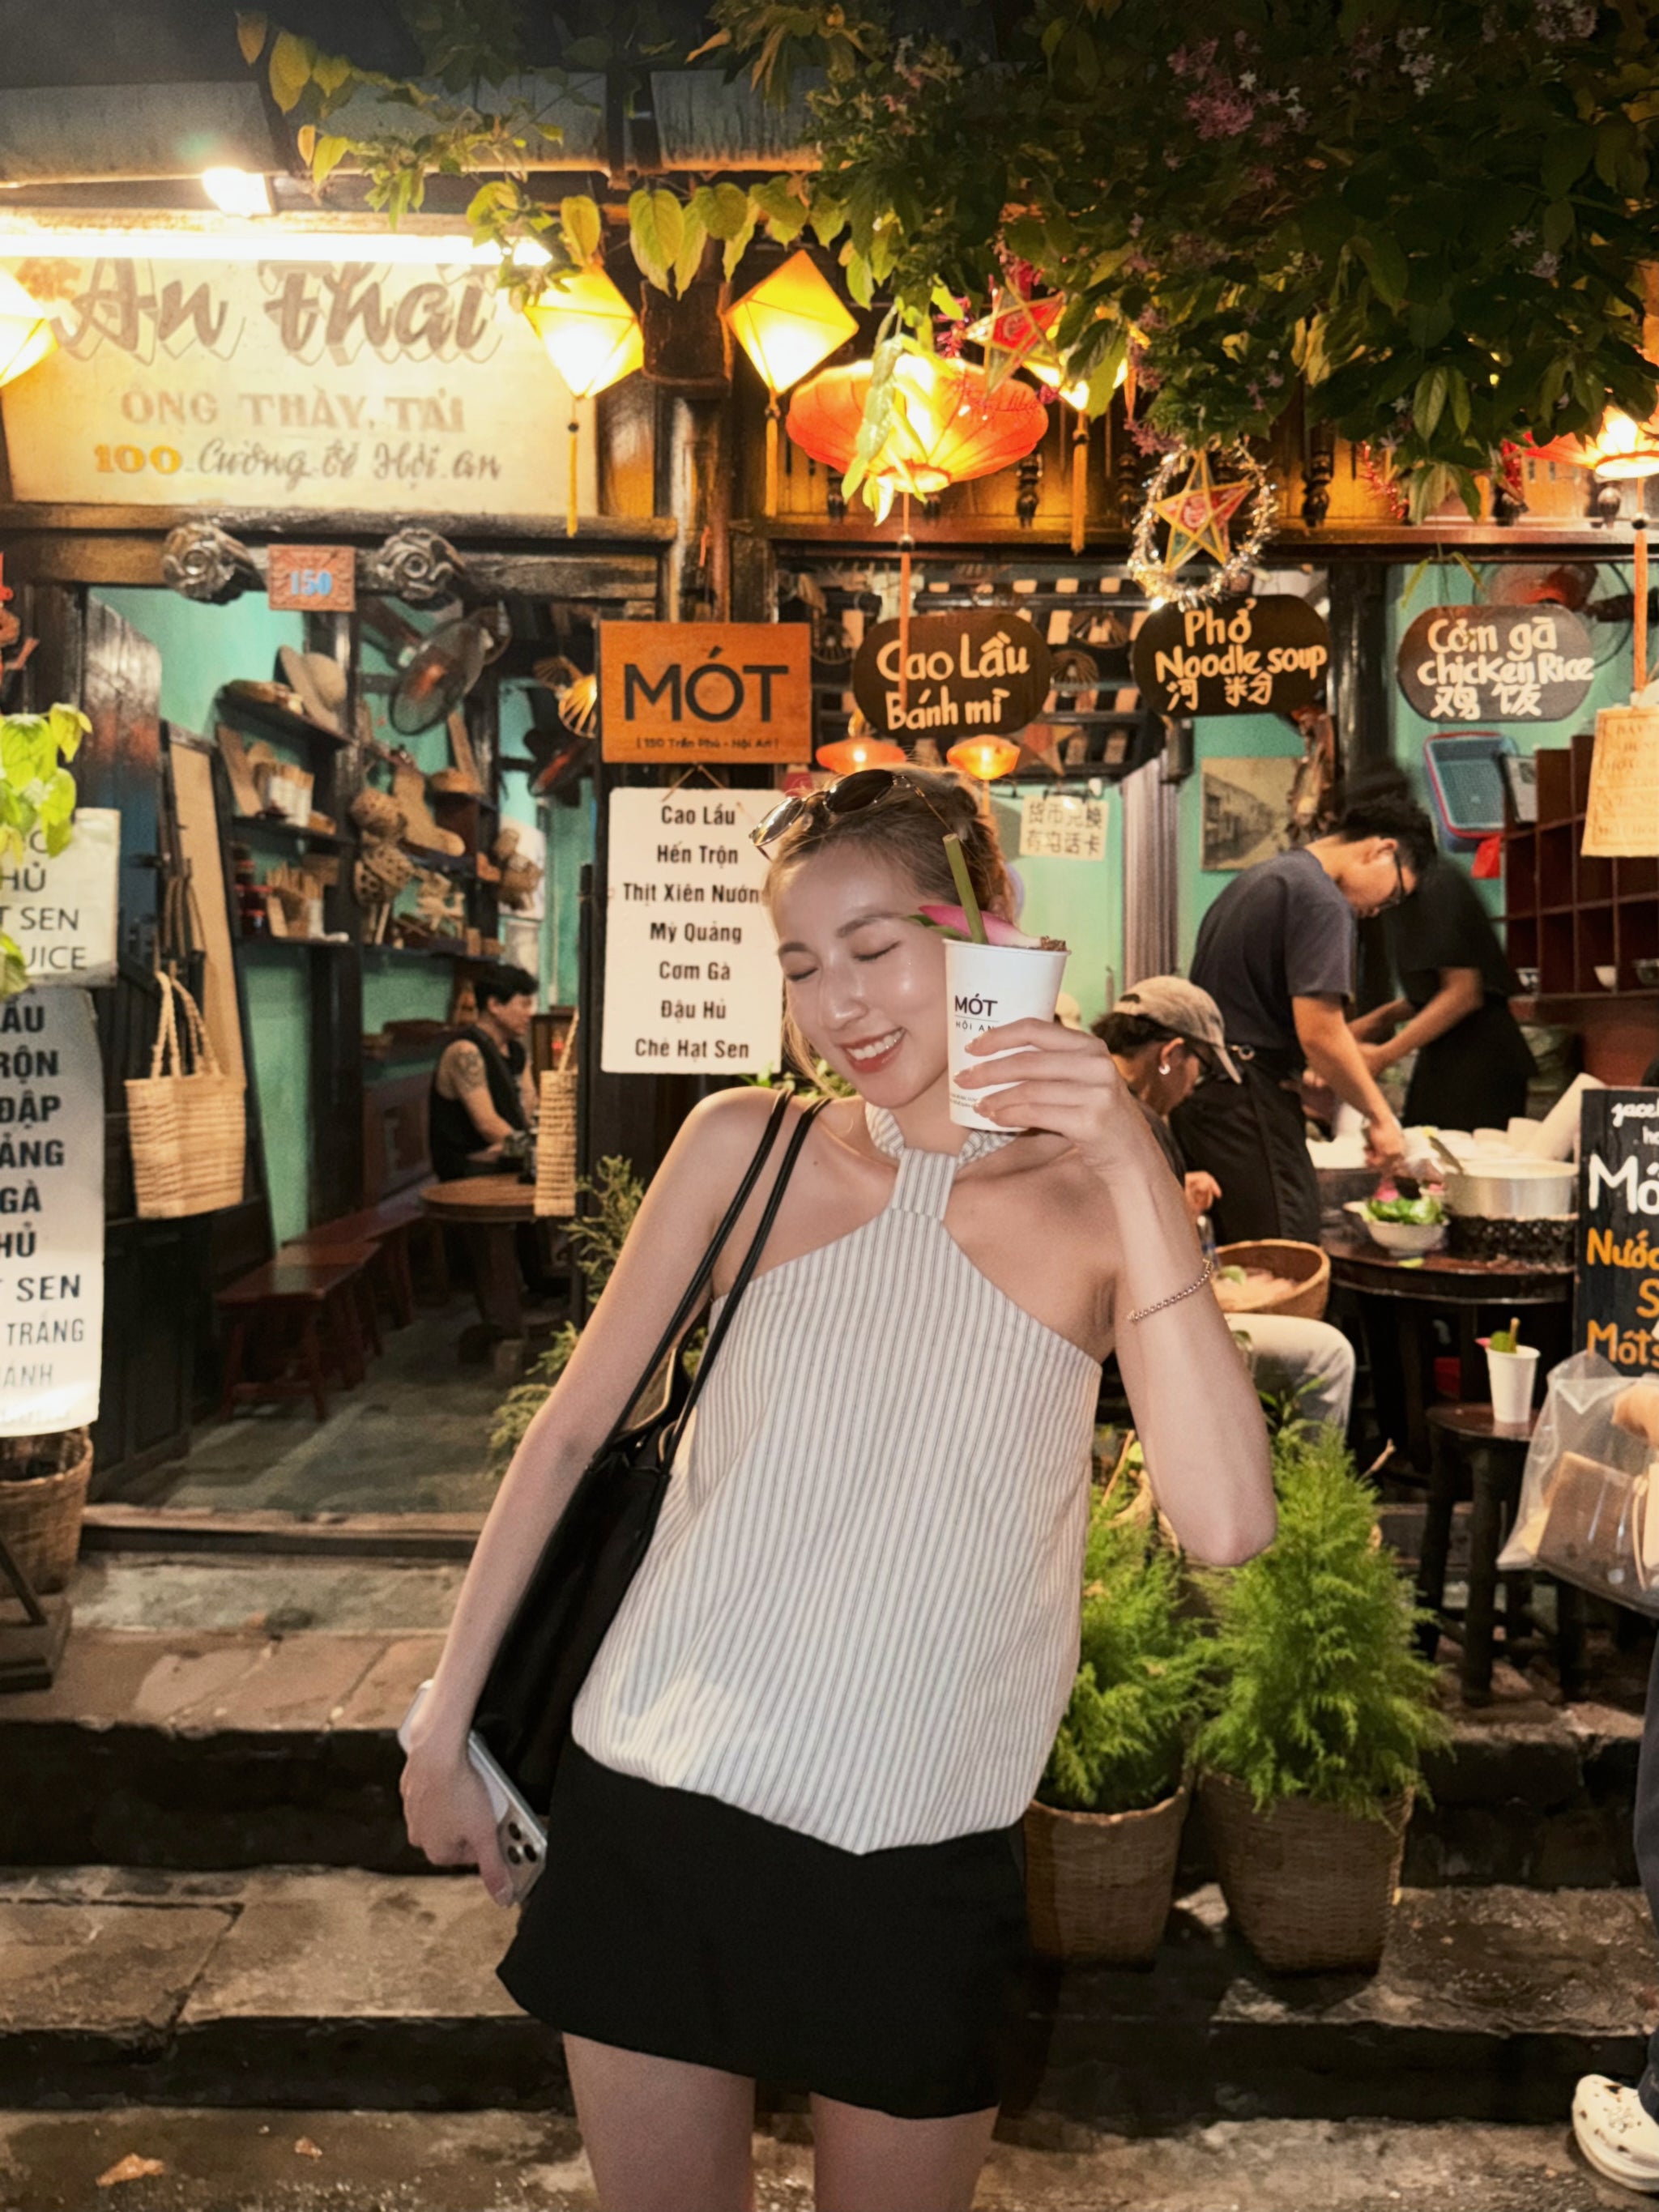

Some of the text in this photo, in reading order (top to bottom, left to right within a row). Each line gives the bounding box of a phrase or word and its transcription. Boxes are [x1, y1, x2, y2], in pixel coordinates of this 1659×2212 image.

[93, 442, 182, 475] 100
[291, 569, 333, 597] 150
[1184, 597, 1257, 648] Phở
[876, 631, 1030, 682] Cao Lầu
[1154, 644, 1328, 684] Noodle soup
[1537, 652, 1595, 684] Rice
[624, 646, 789, 722] MÓT
[885, 685, 959, 731] Bánh
[661, 805, 696, 825] Cao
[657, 841, 739, 868] Hến Trộn
[623, 882, 760, 906] Thịt Xiên Nướn
[20, 906, 79, 931] SEN
[684, 920, 742, 944] Quảng
[659, 961, 731, 981] Cơm Gà
[661, 999, 696, 1023] Đậu
[954, 993, 998, 1016] MÓT
[677, 1039, 707, 1062] Hạt
[714, 1040, 749, 1059] Sen
[16, 1274, 80, 1303] SEN
